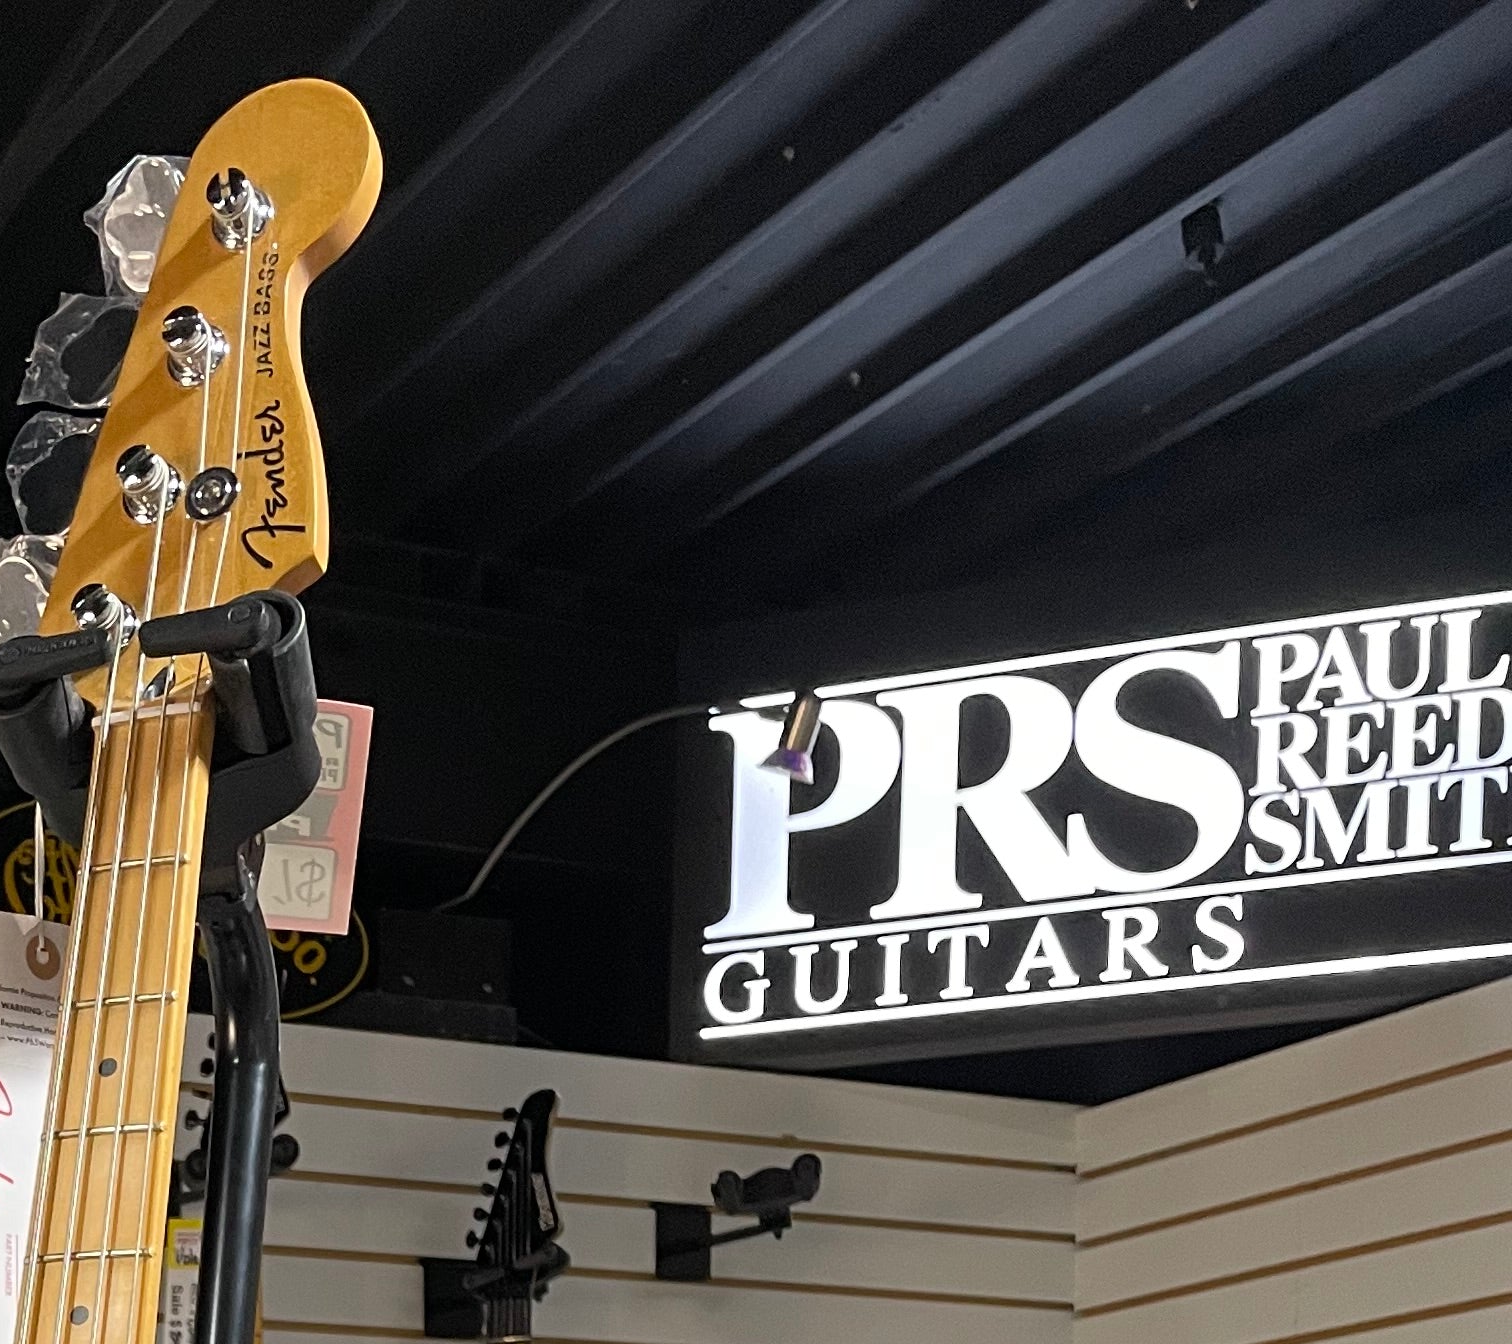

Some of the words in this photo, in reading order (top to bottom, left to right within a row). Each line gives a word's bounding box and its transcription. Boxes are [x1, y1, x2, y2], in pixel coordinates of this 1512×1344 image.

[253, 251, 279, 316] BASS
[252, 322, 274, 379] JAZZ
[237, 400, 306, 568] Fender
[1250, 609, 1510, 717] PAUL
[704, 641, 1246, 940] PRS
[1248, 687, 1512, 797] REED
[1245, 765, 1512, 876] SMIT
[703, 895, 1246, 1025] GUITARS
